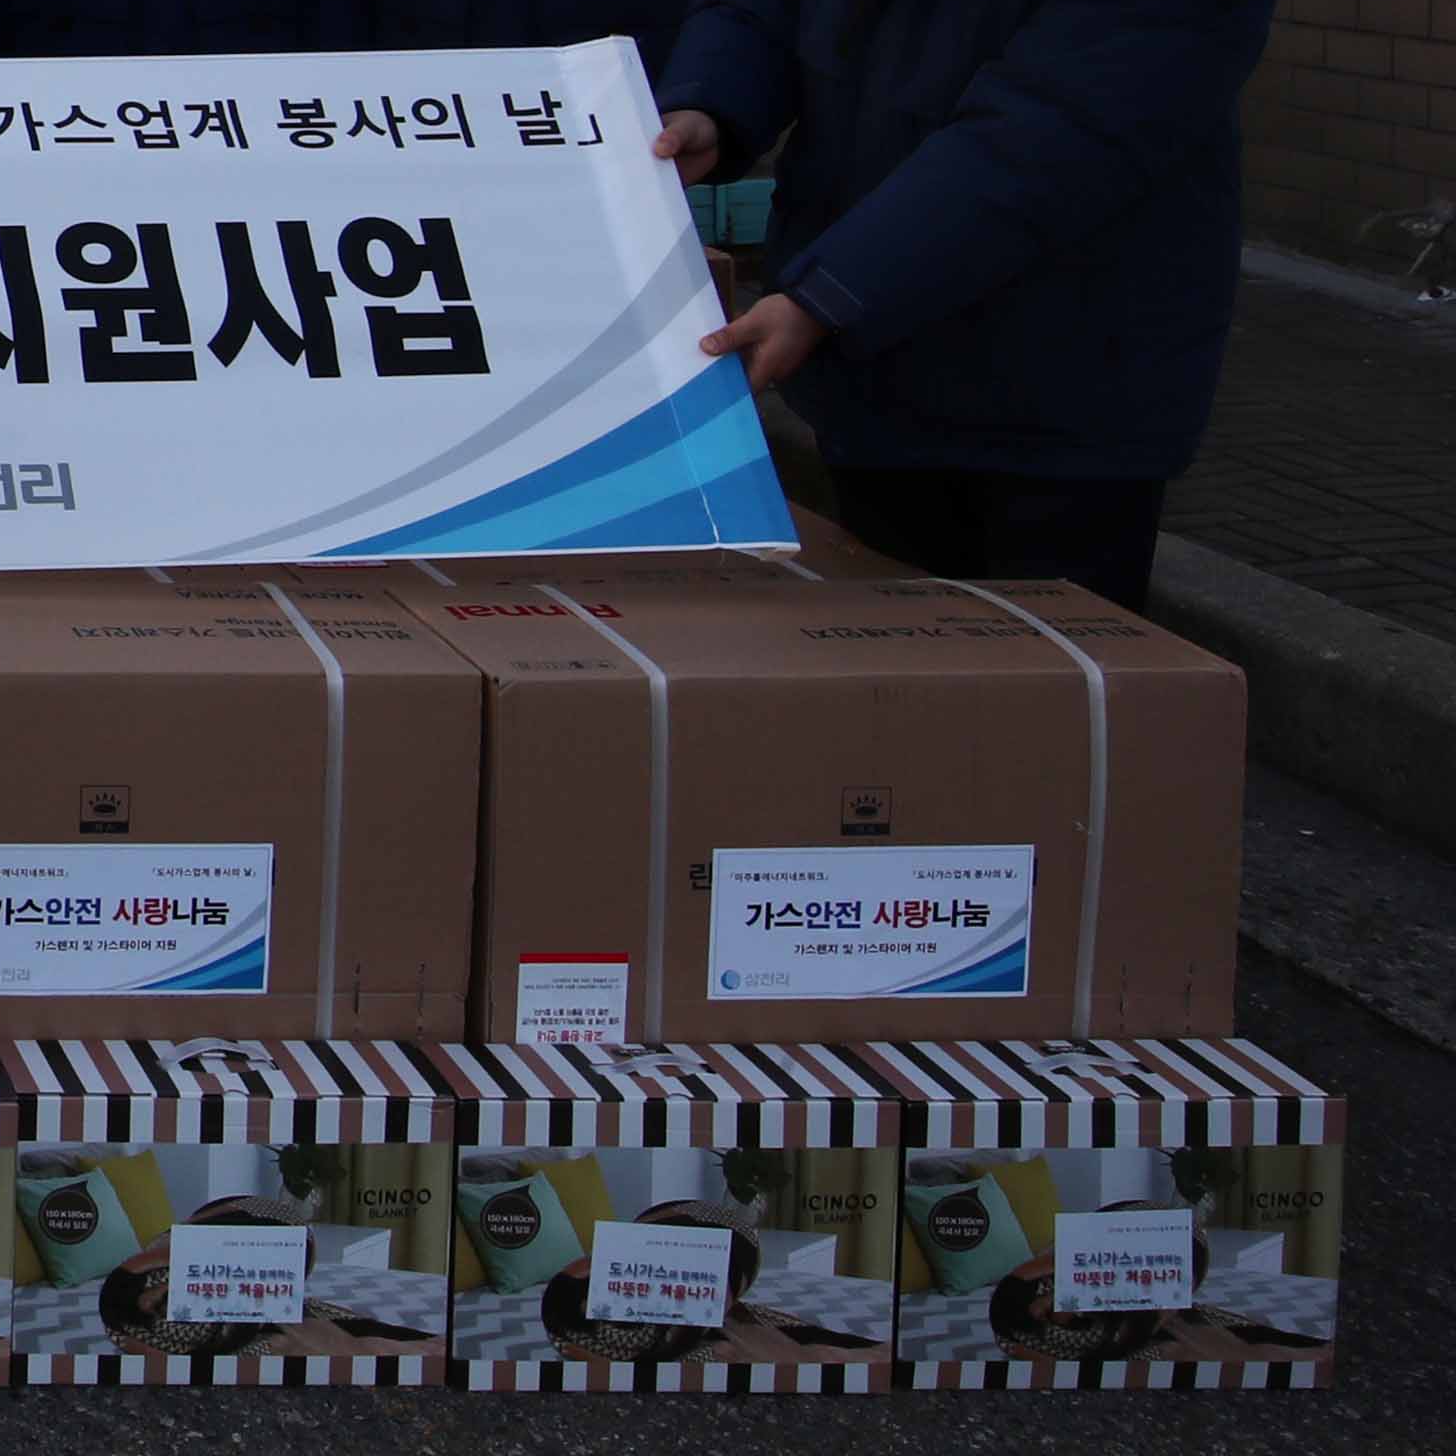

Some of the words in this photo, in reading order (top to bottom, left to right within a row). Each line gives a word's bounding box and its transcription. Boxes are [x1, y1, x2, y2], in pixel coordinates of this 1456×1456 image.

[276, 92, 476, 151] 봉사의
[442, 604, 624, 621] Rnnai
[111, 897, 231, 926] 사랑나눔
[744, 900, 863, 931] 가스안전
[871, 899, 991, 929] 사랑나눔
[1072, 1268, 1117, 1285] 따뜻한
[1125, 1268, 1183, 1285] 겨울나기
[186, 1282, 229, 1298] 따뜻한
[238, 1282, 295, 1298] 겨울나기
[607, 1280, 651, 1298] 따뜻한
[659, 1283, 717, 1301] 겨울나기
